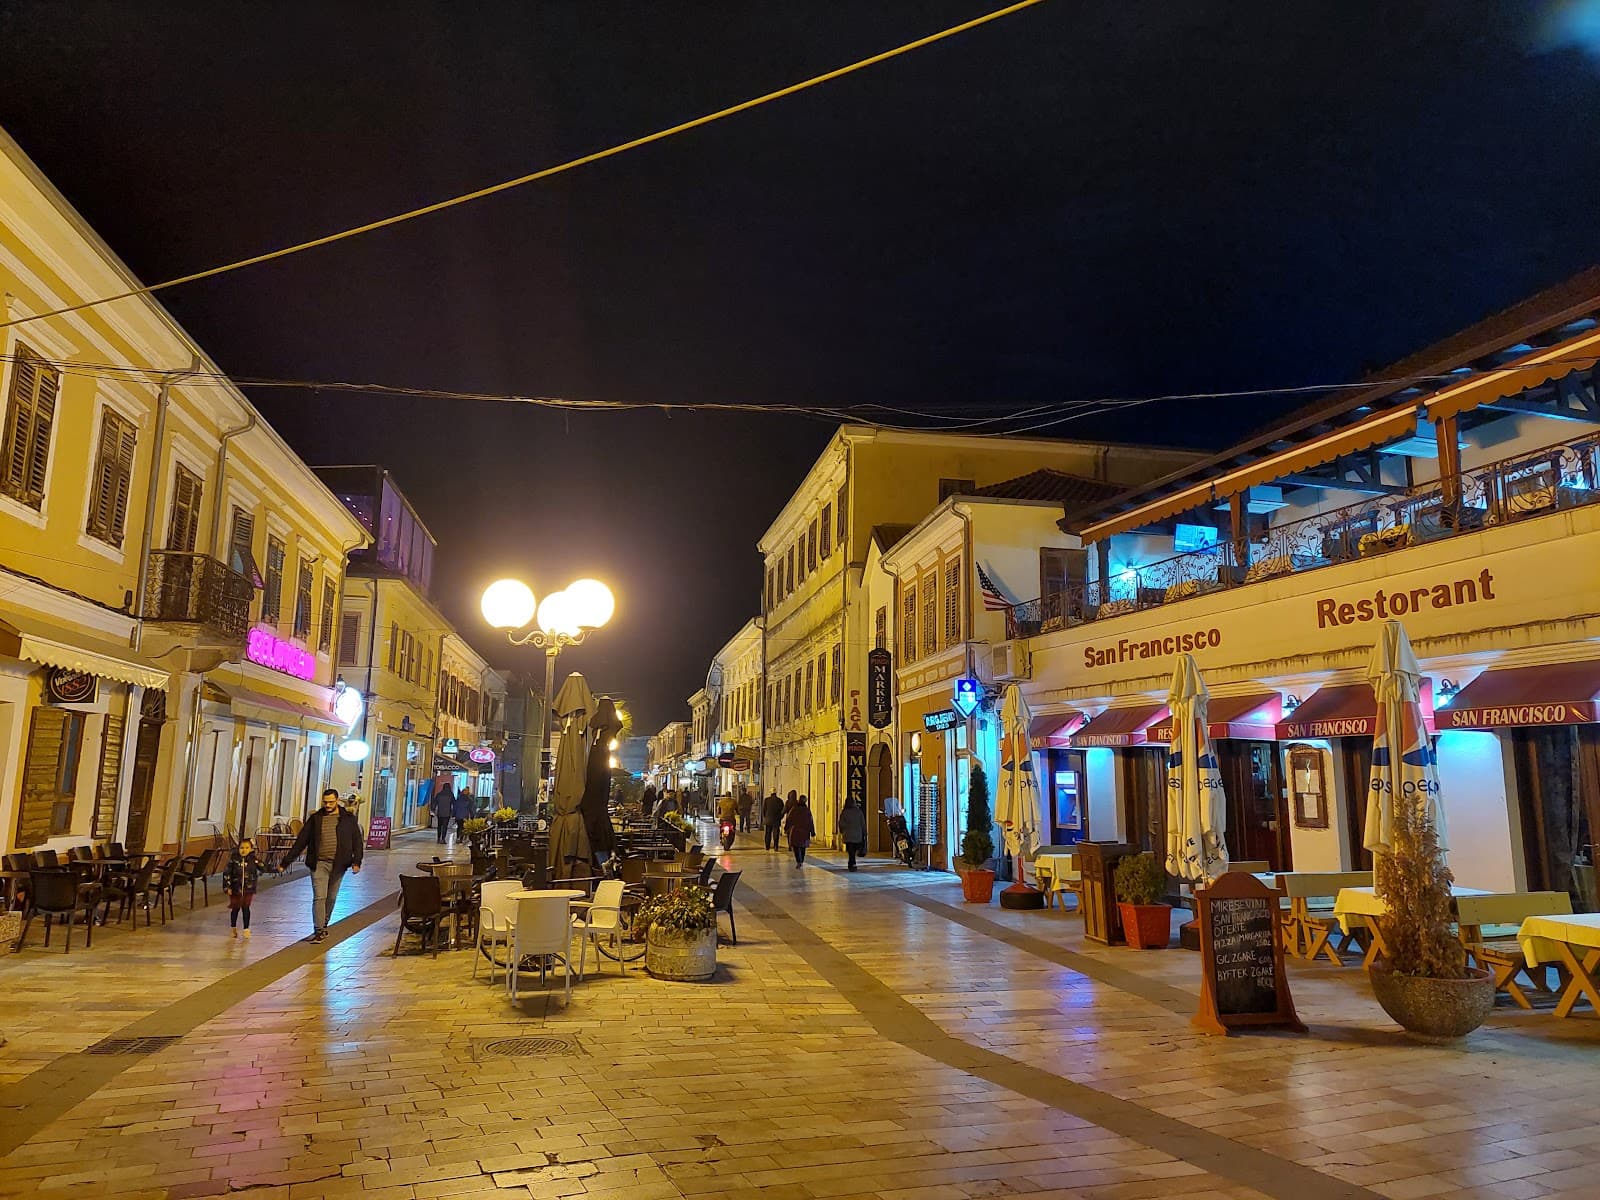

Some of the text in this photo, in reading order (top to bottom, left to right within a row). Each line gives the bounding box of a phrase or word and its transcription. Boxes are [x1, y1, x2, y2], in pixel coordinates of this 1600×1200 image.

[1316, 567, 1496, 629] Restorant
[873, 665, 886, 712] MARKET
[1452, 704, 1566, 727] SAN FRANCISCO
[1287, 719, 1368, 738] SAN FRANCISCO
[1076, 734, 1122, 747] SAN FRANCISCO
[1217, 967, 1249, 981] BYFTEK
